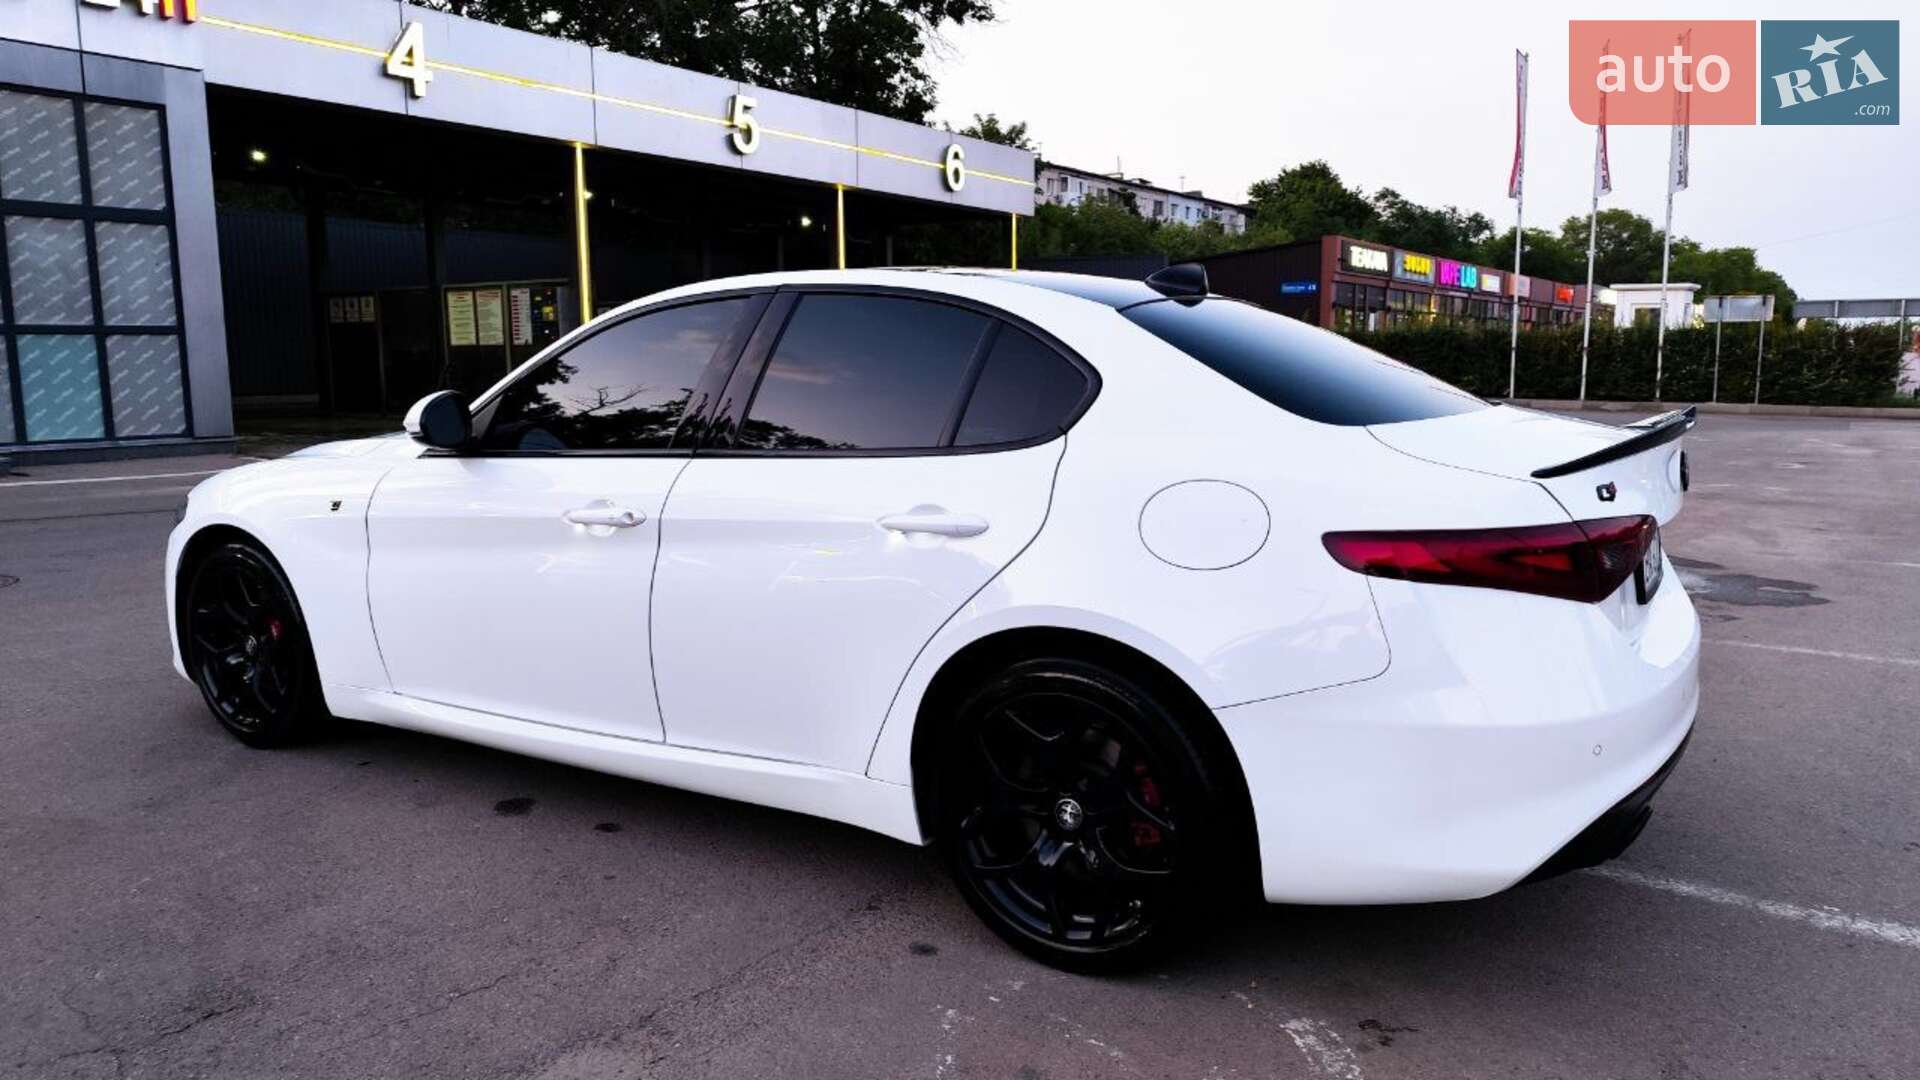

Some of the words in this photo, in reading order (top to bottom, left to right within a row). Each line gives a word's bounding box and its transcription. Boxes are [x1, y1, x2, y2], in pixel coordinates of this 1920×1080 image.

[386, 22, 433, 97] 4
[731, 94, 760, 154] 5
[945, 143, 965, 191] 6
